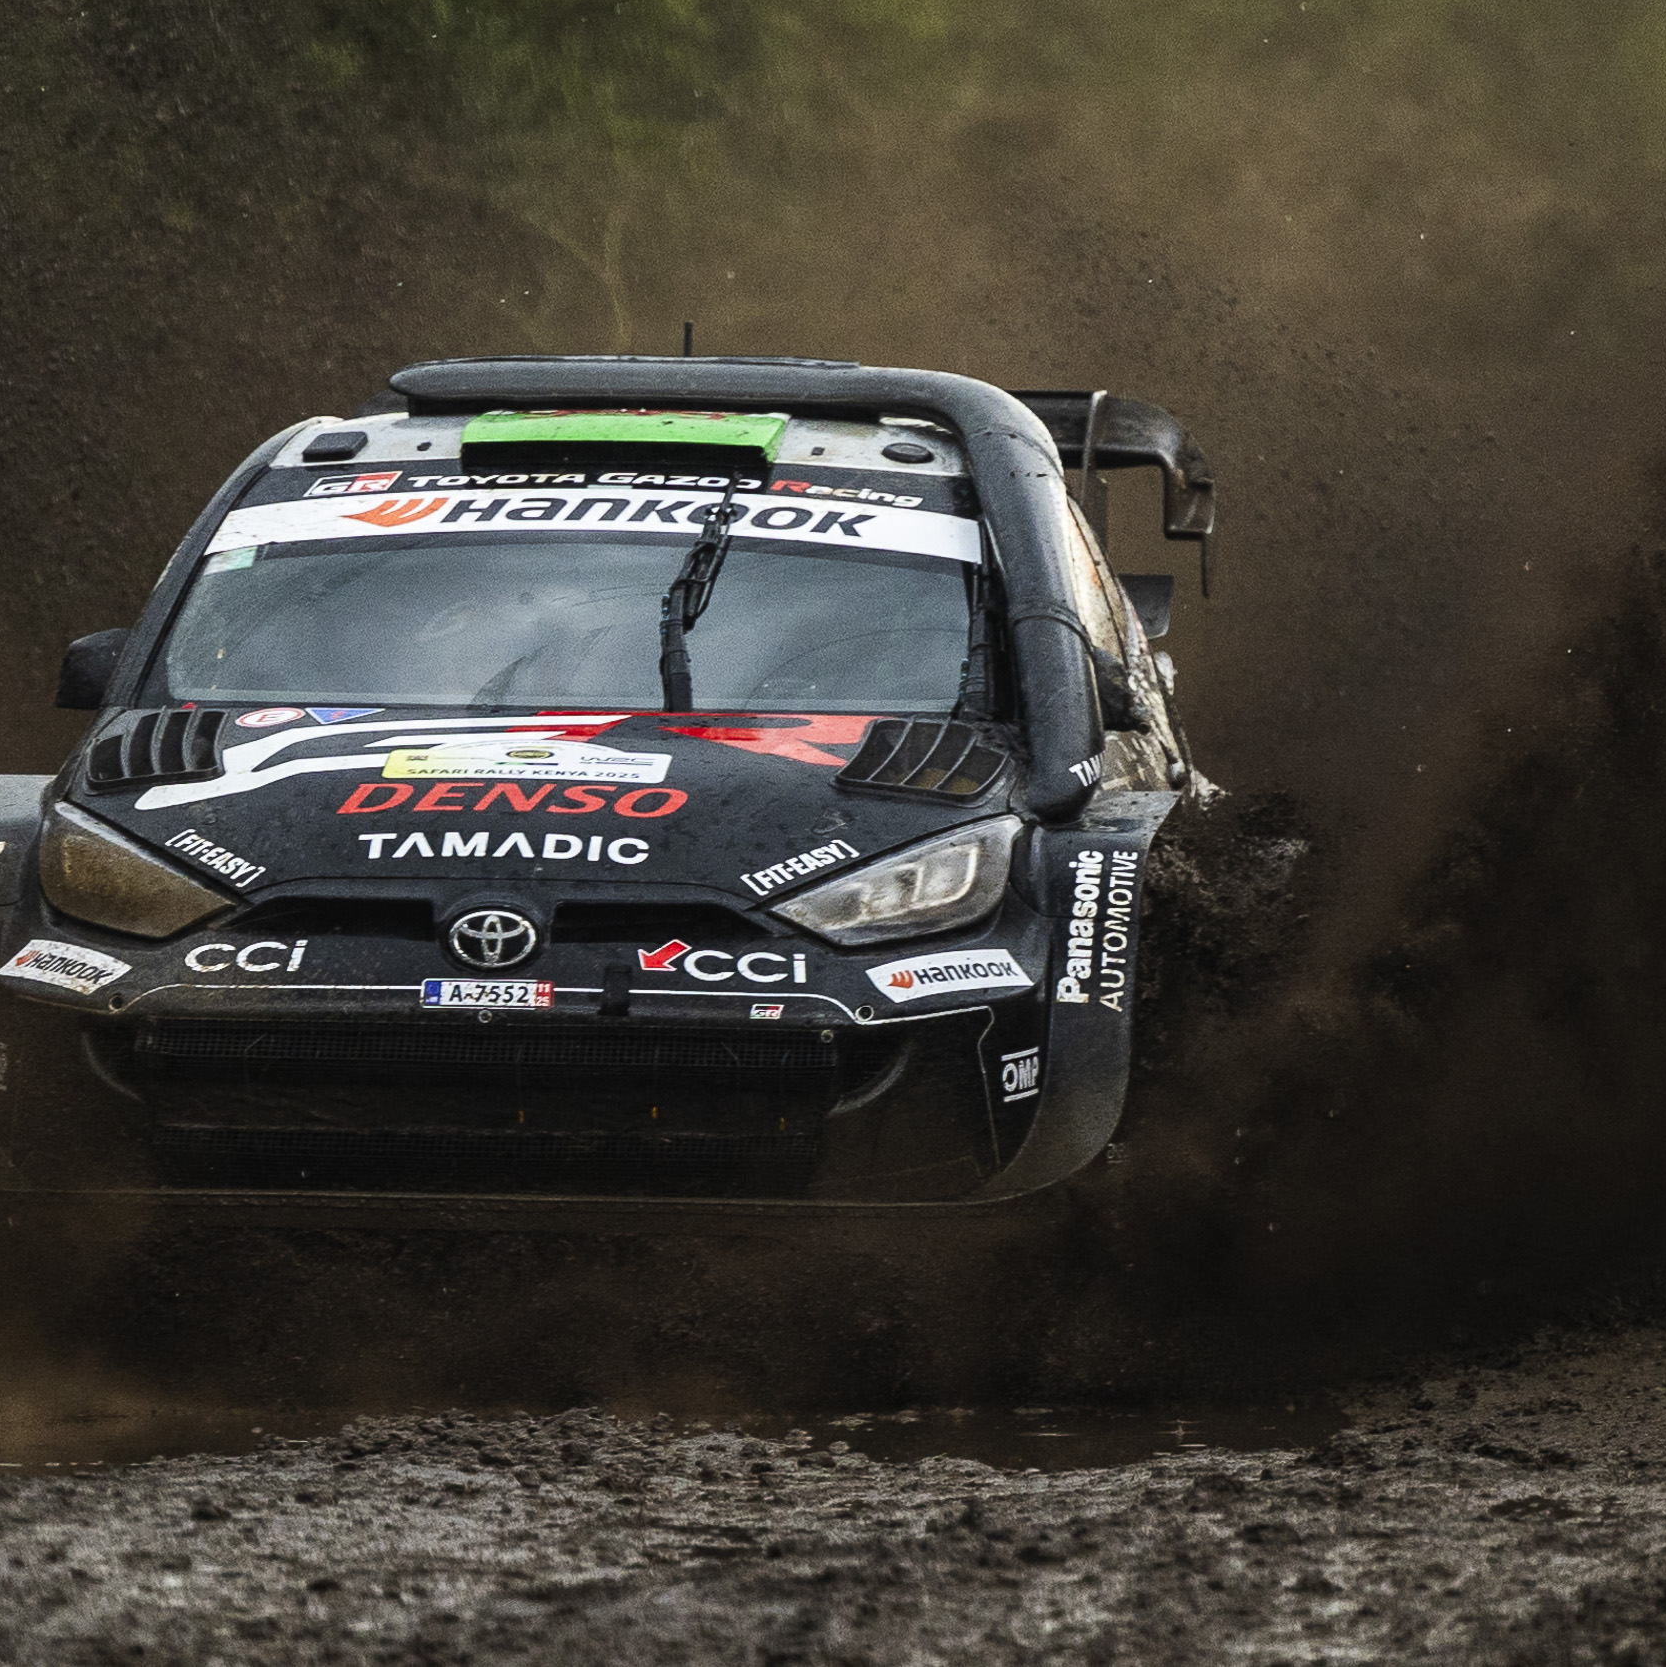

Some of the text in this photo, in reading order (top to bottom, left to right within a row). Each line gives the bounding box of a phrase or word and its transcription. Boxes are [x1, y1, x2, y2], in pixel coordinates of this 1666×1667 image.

[408, 473, 586, 488] TOYOTA
[770, 479, 924, 508] Racing
[532, 769, 588, 777] KENYA
[594, 771, 640, 779] 2025
[336, 782, 689, 819] DENSO
[358, 831, 650, 865] TAMADIC
[1056, 850, 1104, 1004] Panasonic
[1099, 850, 1138, 1012] AUTOMOTIVE
